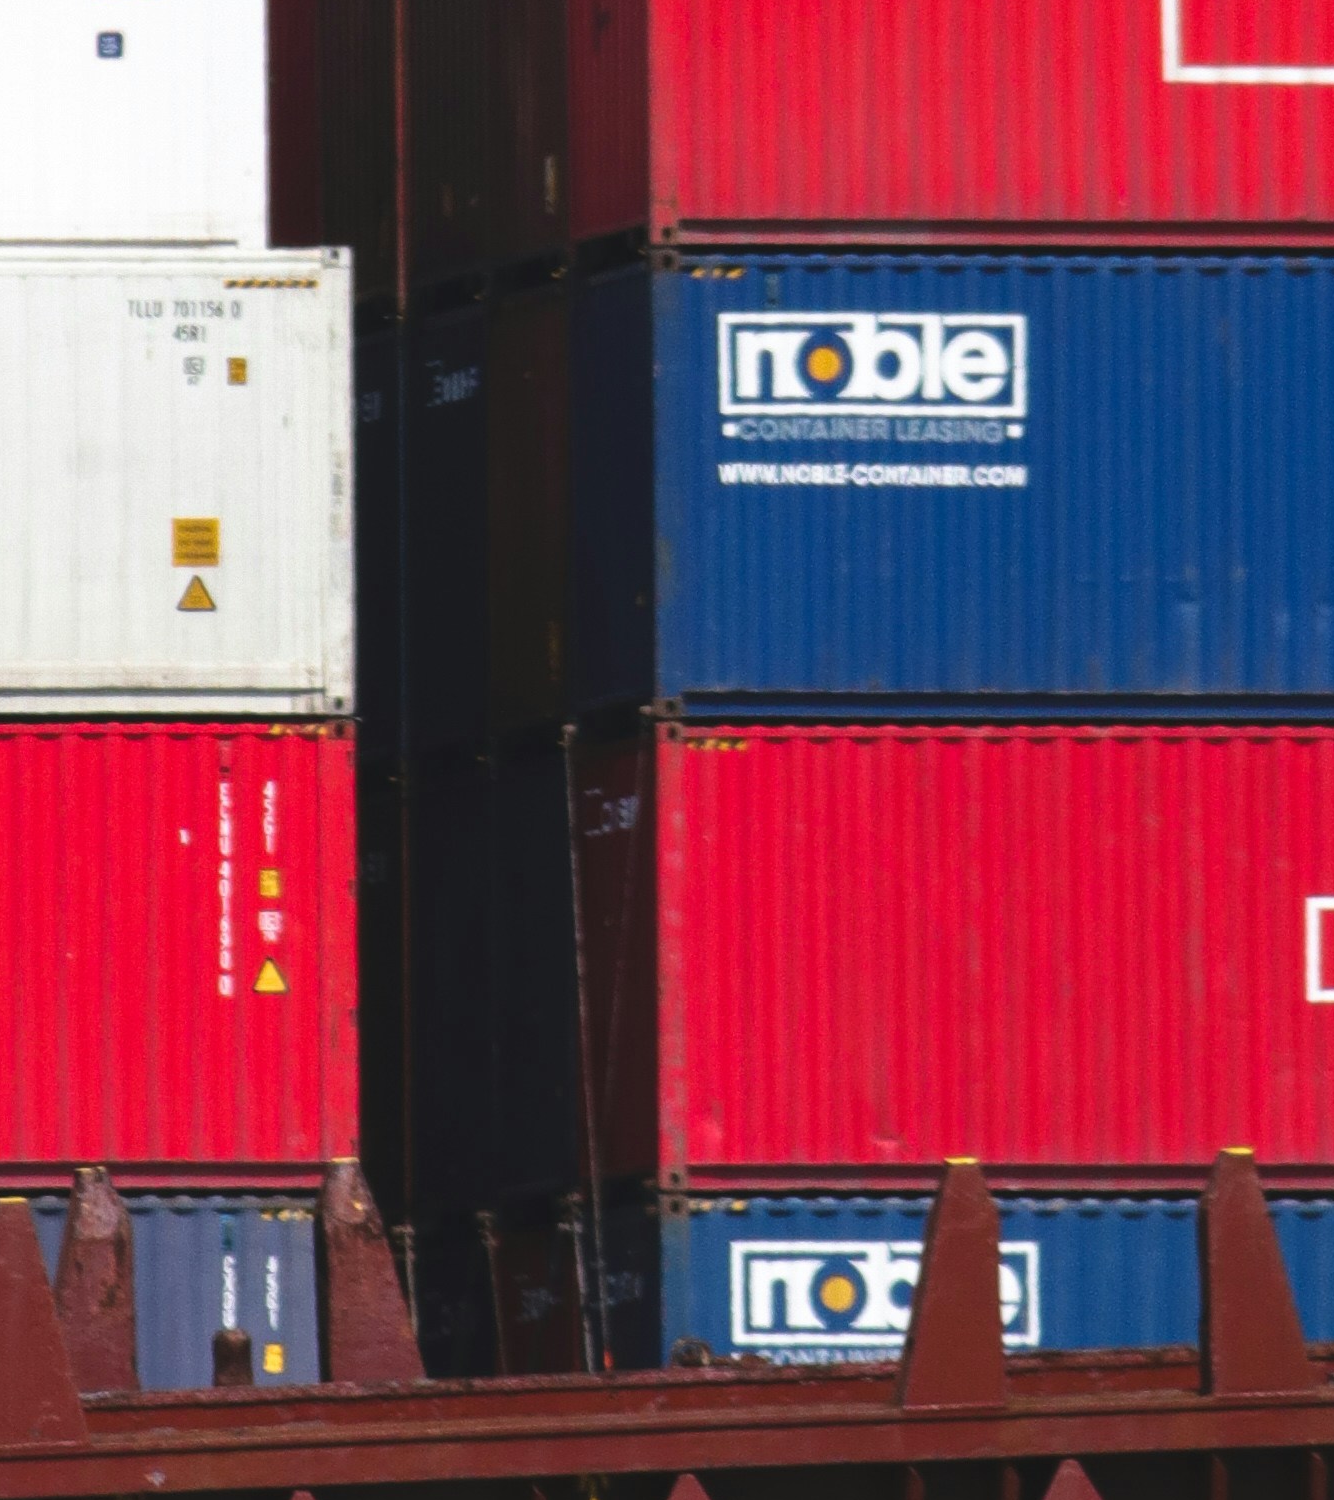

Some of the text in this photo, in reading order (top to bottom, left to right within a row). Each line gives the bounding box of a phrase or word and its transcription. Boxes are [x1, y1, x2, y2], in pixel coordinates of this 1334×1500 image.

[734, 313, 1011, 402] noble
[738, 418, 1004, 443] CONTAINER LEASING
[718, 463, 1027, 487] WWW.NOBLE-CONTAINER.COM
